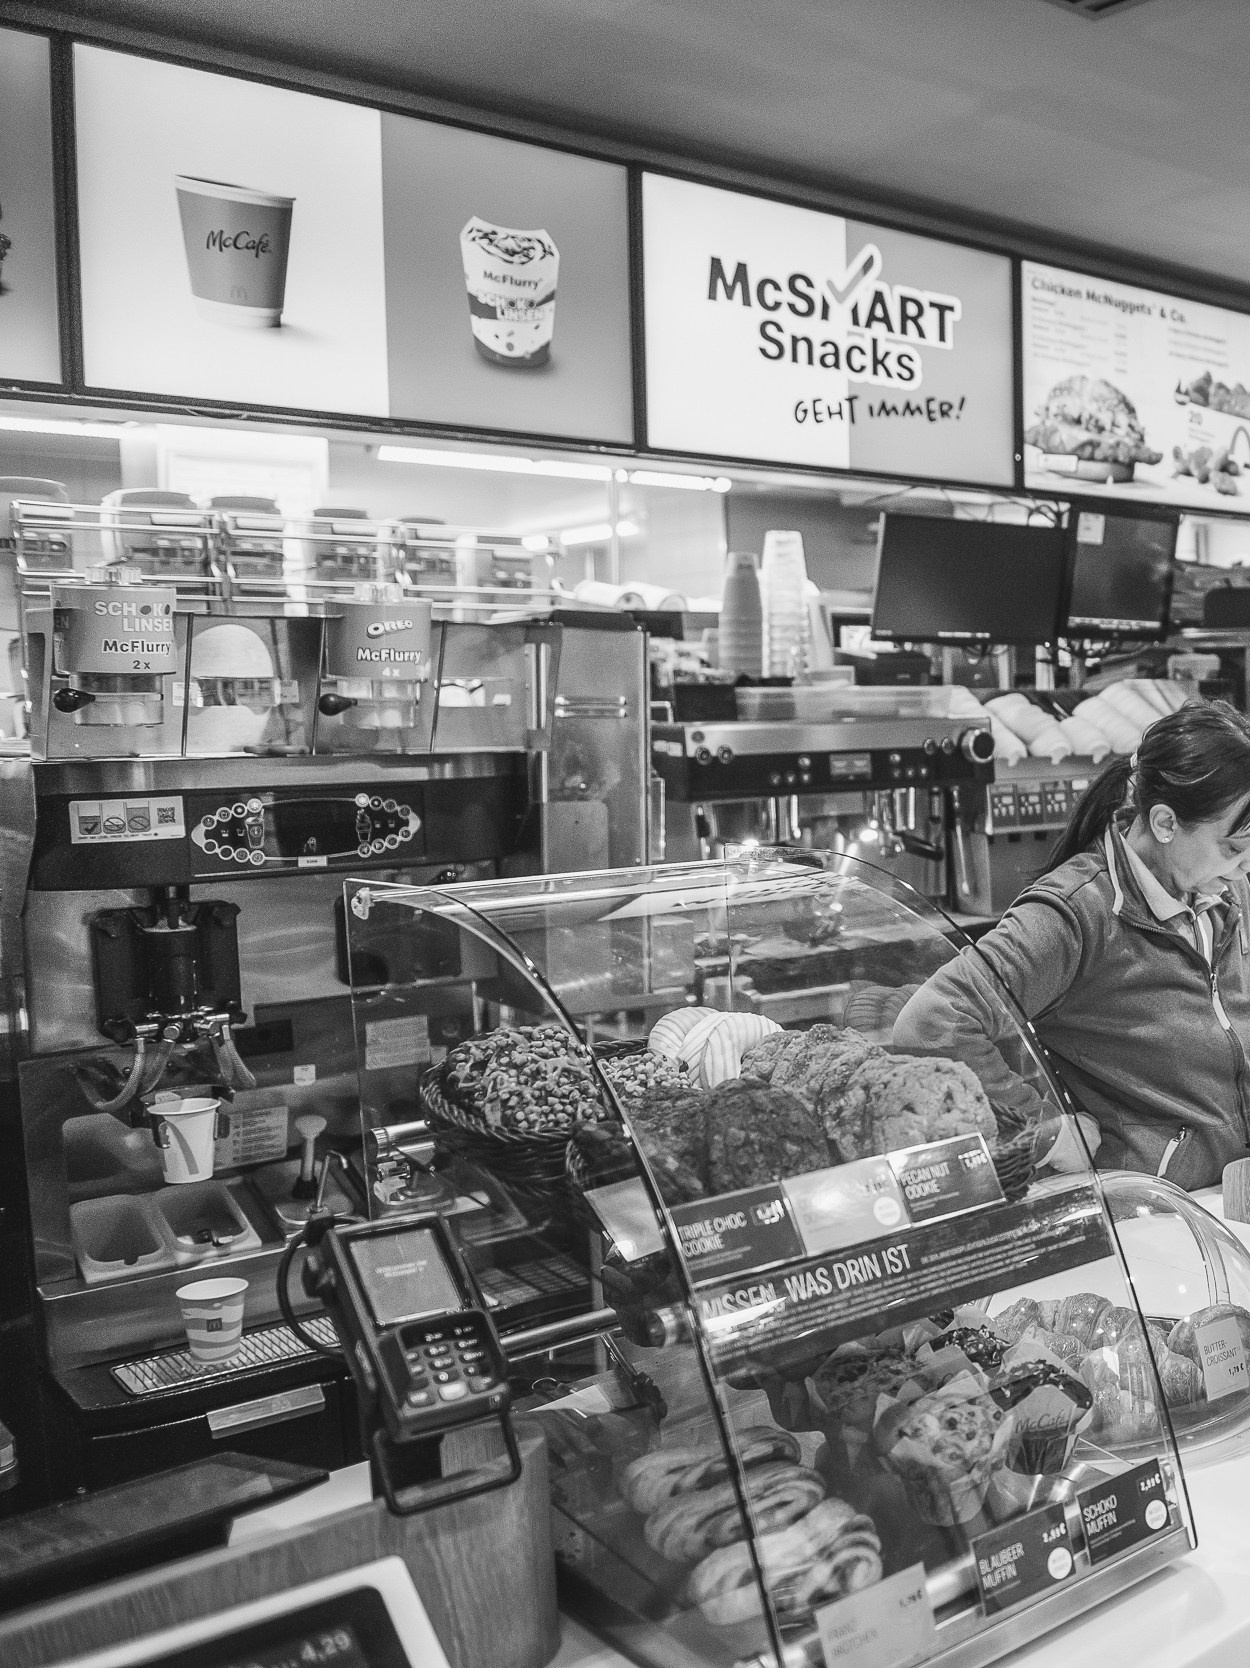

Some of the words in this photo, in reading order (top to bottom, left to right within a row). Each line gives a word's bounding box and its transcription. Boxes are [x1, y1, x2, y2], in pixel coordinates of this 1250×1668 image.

[206, 229, 268, 258] McCafé
[483, 270, 538, 290] McFlurry
[759, 320, 916, 382] Snacks
[794, 396, 858, 424] GEHT
[868, 397, 966, 422] IMMER!
[123, 618, 173, 632] LINSE
[103, 640, 171, 656] McFlurry
[357, 647, 421, 665] McFlurry
[905, 1180, 941, 1200] COOKIE
[713, 1211, 747, 1233] CHOC
[682, 1233, 726, 1258] COOKIE
[784, 1266, 833, 1303] WAS
[832, 1253, 882, 1290] DRIN
[881, 1244, 911, 1275] IST
[1083, 1494, 1117, 1522] SCHOKO
[1086, 1510, 1117, 1536] MUFFIN
[982, 1561, 1017, 1591] MUFFIN
